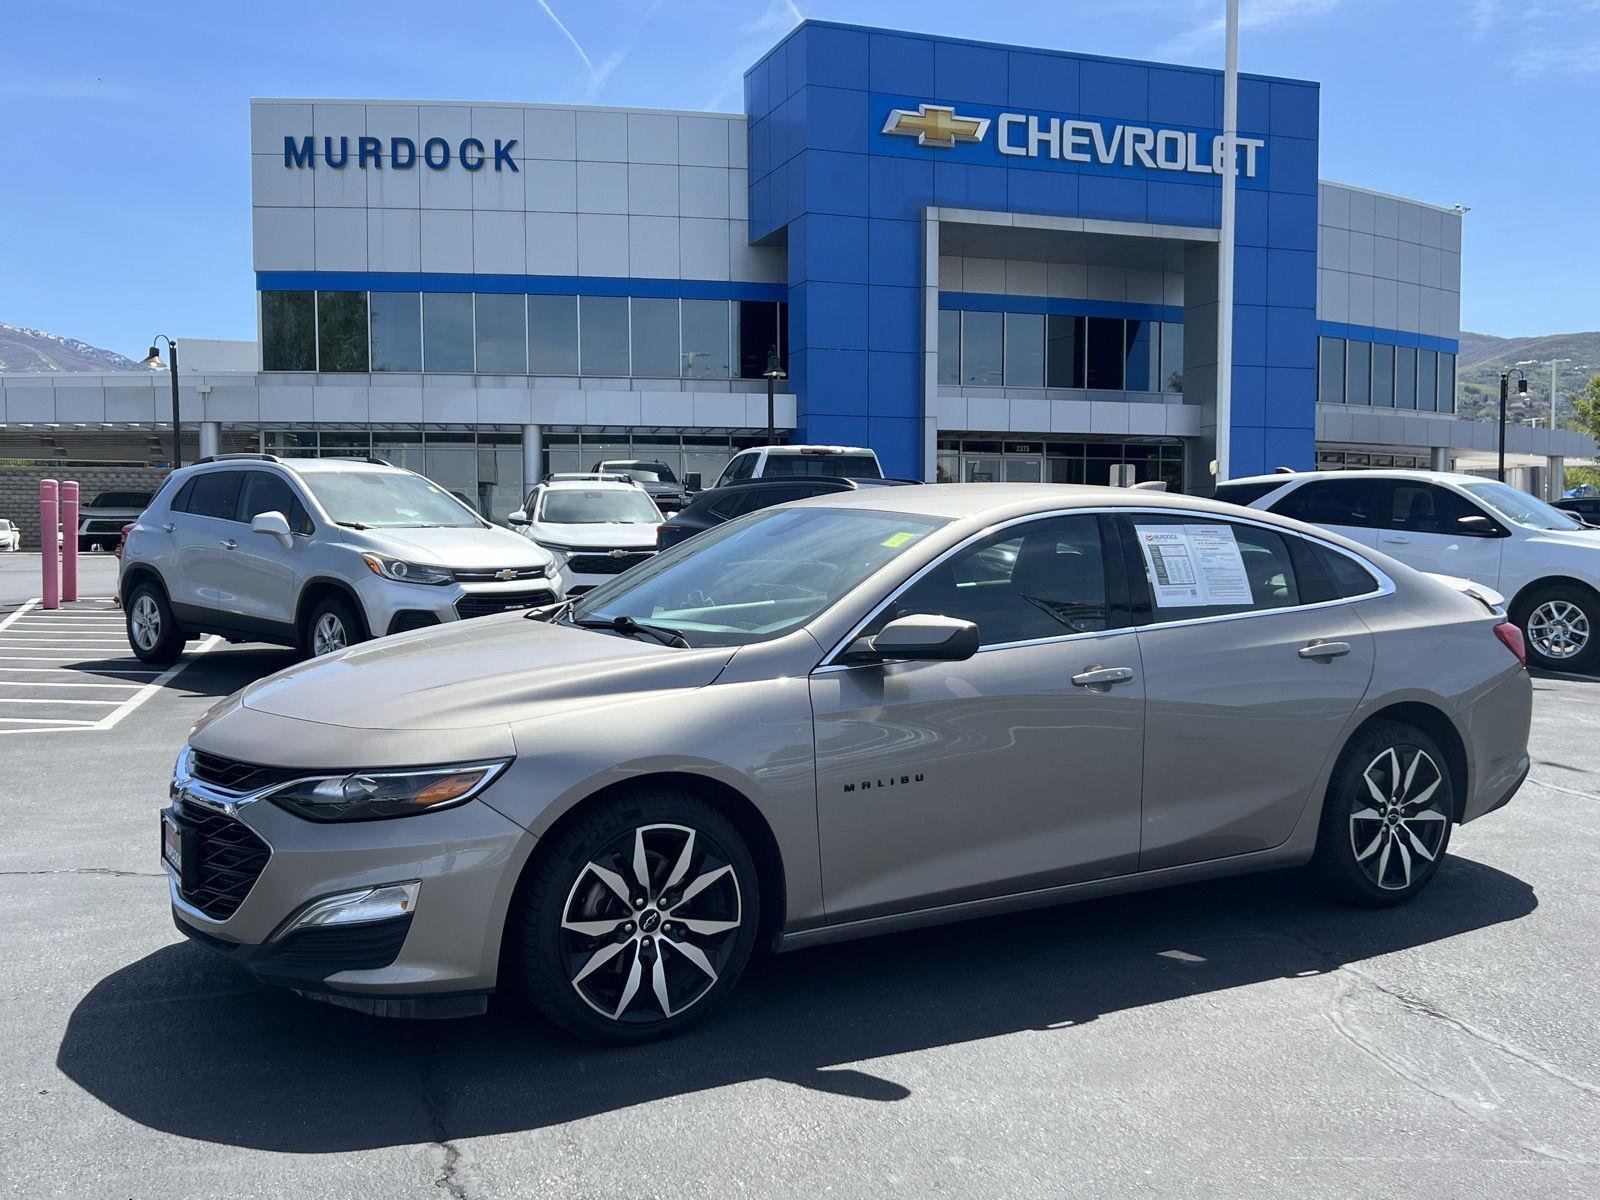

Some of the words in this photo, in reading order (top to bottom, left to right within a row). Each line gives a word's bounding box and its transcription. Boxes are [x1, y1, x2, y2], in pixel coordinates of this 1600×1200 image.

[284, 136, 519, 172] MURDOCK
[998, 113, 1264, 177] CHEVROLET
[844, 774, 924, 792] MALIBU
